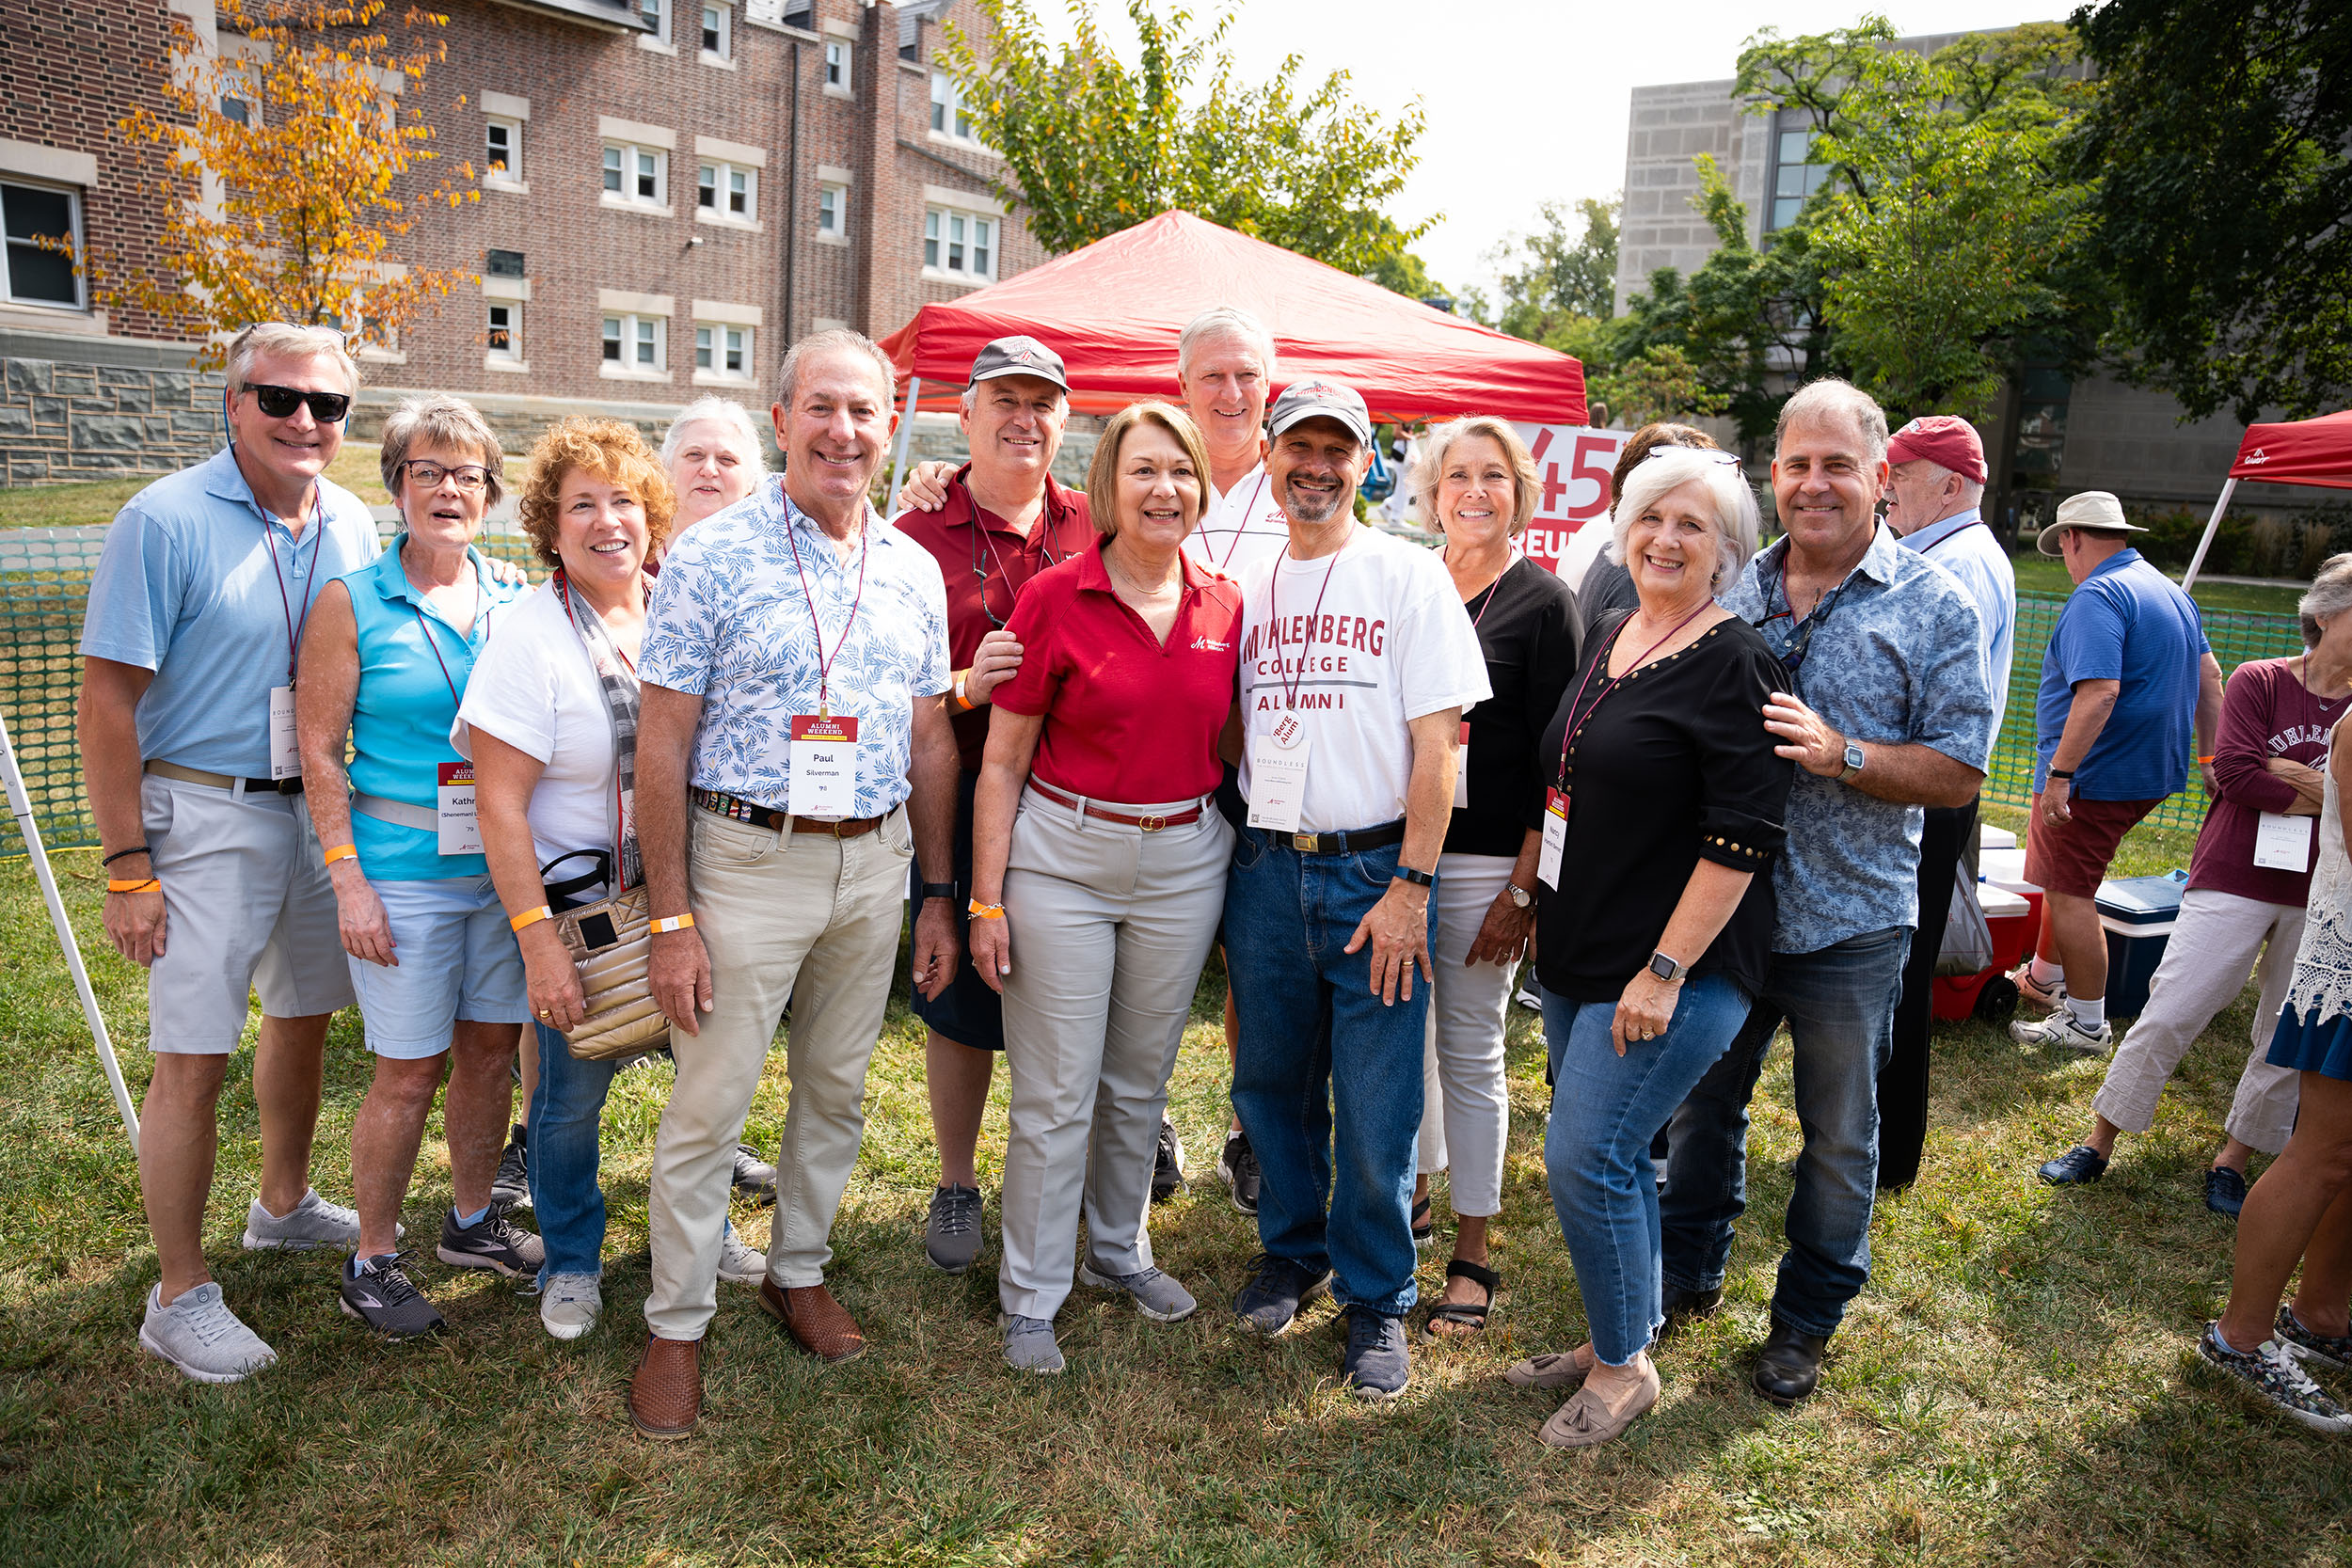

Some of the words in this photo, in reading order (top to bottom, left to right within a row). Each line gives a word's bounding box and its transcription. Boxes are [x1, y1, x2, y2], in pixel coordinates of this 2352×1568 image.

[1508, 529, 1577, 560] REU
[1257, 657, 1348, 675] COLLEGE
[1273, 715, 1293, 737] 'Berg
[1279, 720, 1299, 745] Alum
[2266, 724, 2330, 757] UHLEN
[813, 753, 834, 763] Paul
[1257, 757, 1305, 768] BOUNDLESS
[452, 797, 475, 805] Kathr
